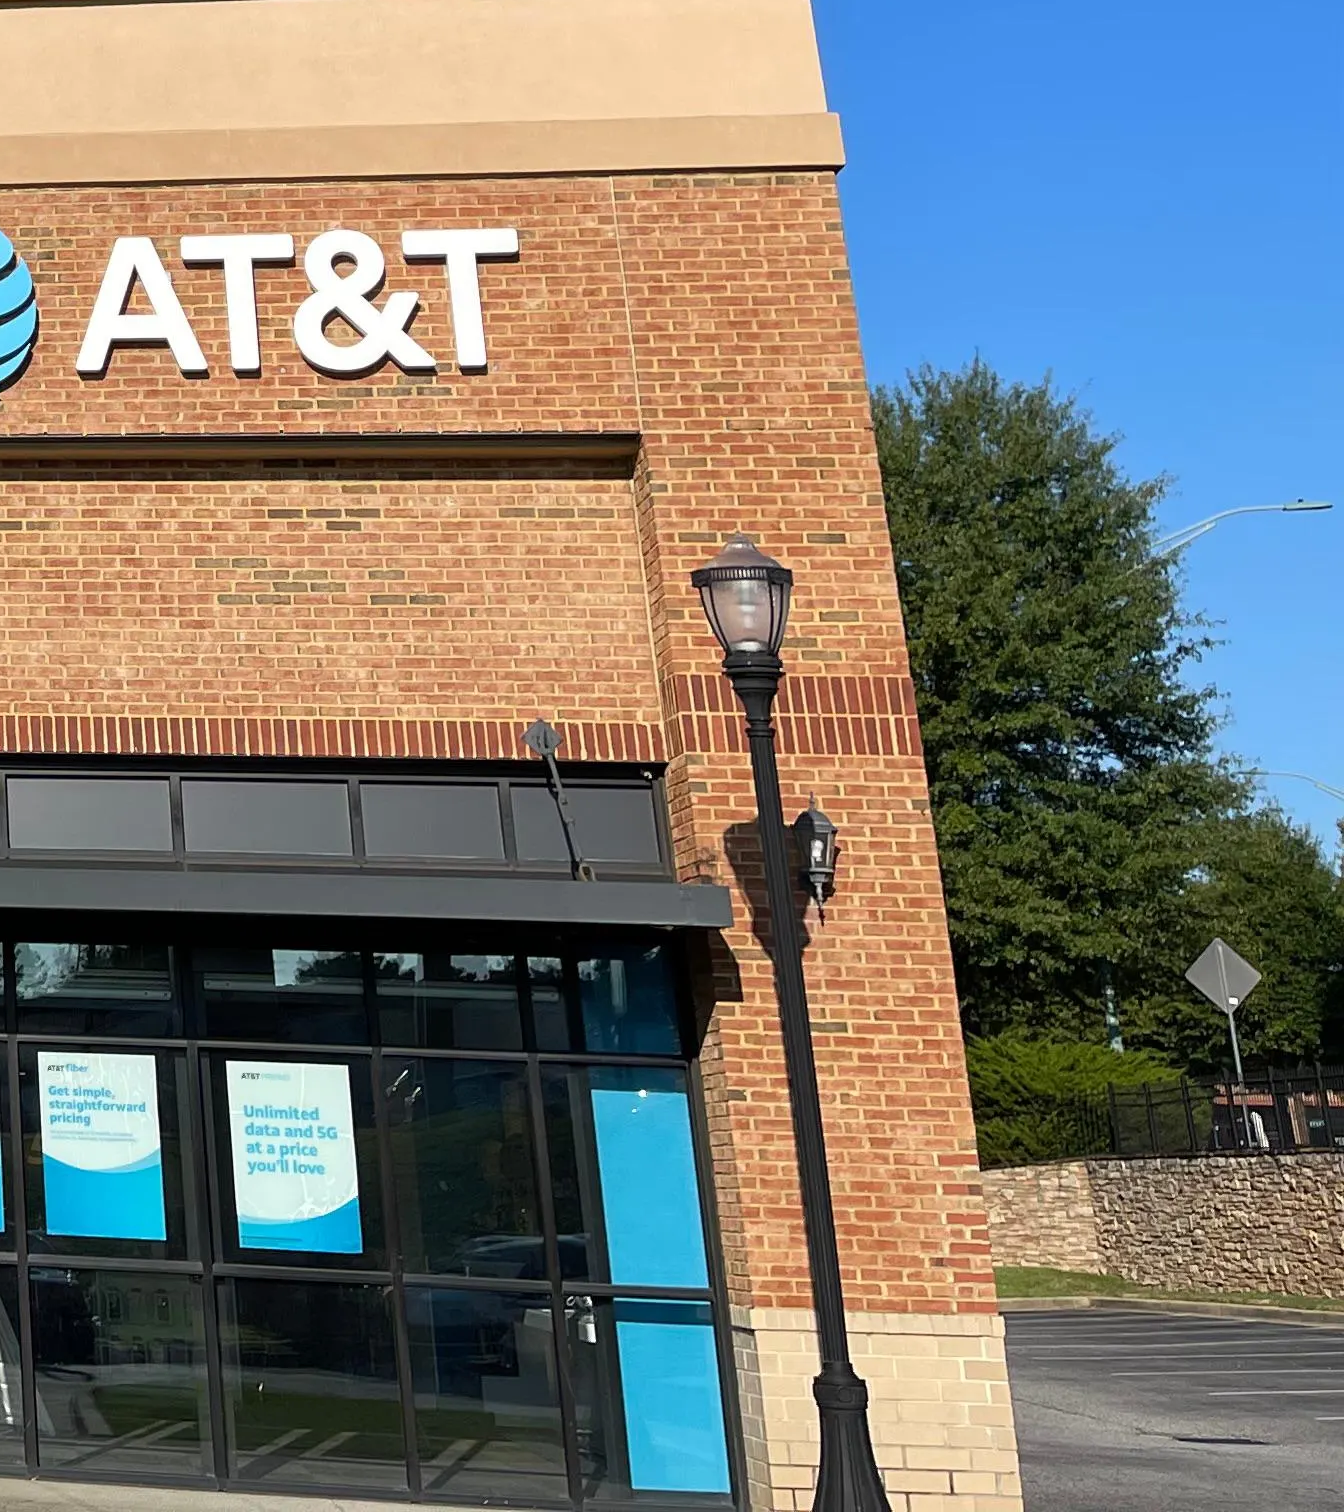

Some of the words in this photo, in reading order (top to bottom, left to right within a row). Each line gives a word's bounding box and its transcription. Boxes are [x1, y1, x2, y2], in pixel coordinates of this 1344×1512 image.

[75, 228, 520, 379] AT&T
[47, 1064, 65, 1072] AT&T
[65, 1063, 89, 1073] fiber
[240, 1072, 261, 1080] AT&T
[48, 1085, 71, 1096] Get
[72, 1086, 116, 1100] simple,
[48, 1099, 147, 1113] straightforward
[243, 1105, 320, 1121] Unlimited
[49, 1112, 91, 1127] pricing
[244, 1122, 281, 1137] data
[284, 1124, 314, 1139] and
[316, 1126, 339, 1140] 5G
[246, 1141, 263, 1154] at
[266, 1144, 276, 1155] a
[279, 1142, 318, 1159] price
[247, 1159, 289, 1176] you'll
[293, 1159, 326, 1175] love
